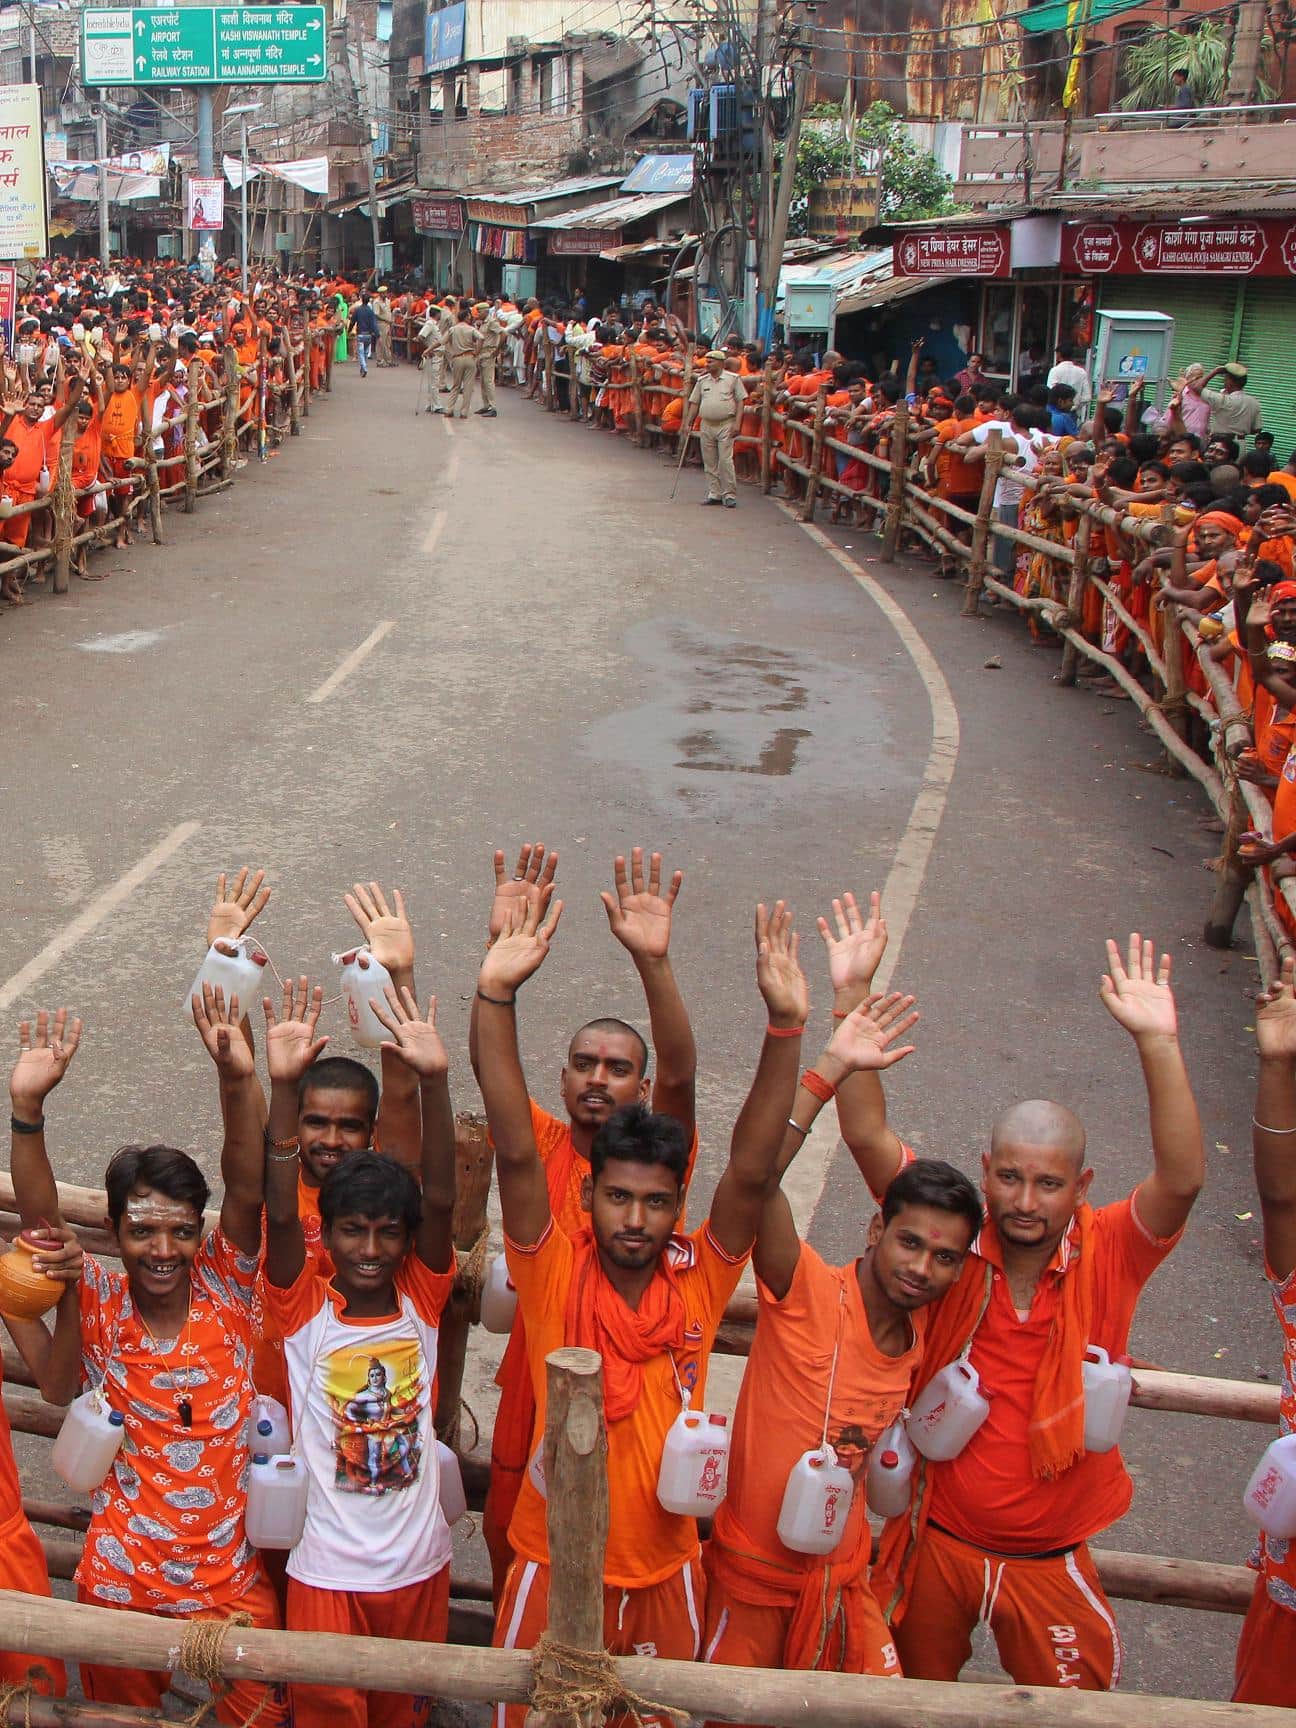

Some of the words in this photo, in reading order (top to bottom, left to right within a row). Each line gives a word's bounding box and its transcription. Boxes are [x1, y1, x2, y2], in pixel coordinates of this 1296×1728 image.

[220, 10, 238, 24] काशी
[276, 10, 294, 24] मंदिर
[150, 31, 180, 42] AIRPORT
[220, 31, 240, 41] KASHI
[242, 30, 280, 40] VISWANATH
[281, 29, 307, 40] TEMPLE
[265, 45, 283, 59] मंदिर
[151, 66, 180, 77] RAILWAY
[181, 66, 210, 76] STATION
[221, 65, 236, 76] MAA
[237, 64, 278, 75] ANNAPURNA
[279, 64, 305, 75] TEMPLE
[1164, 226, 1182, 246] काशी
[1199, 230, 1213, 250] पूजा
